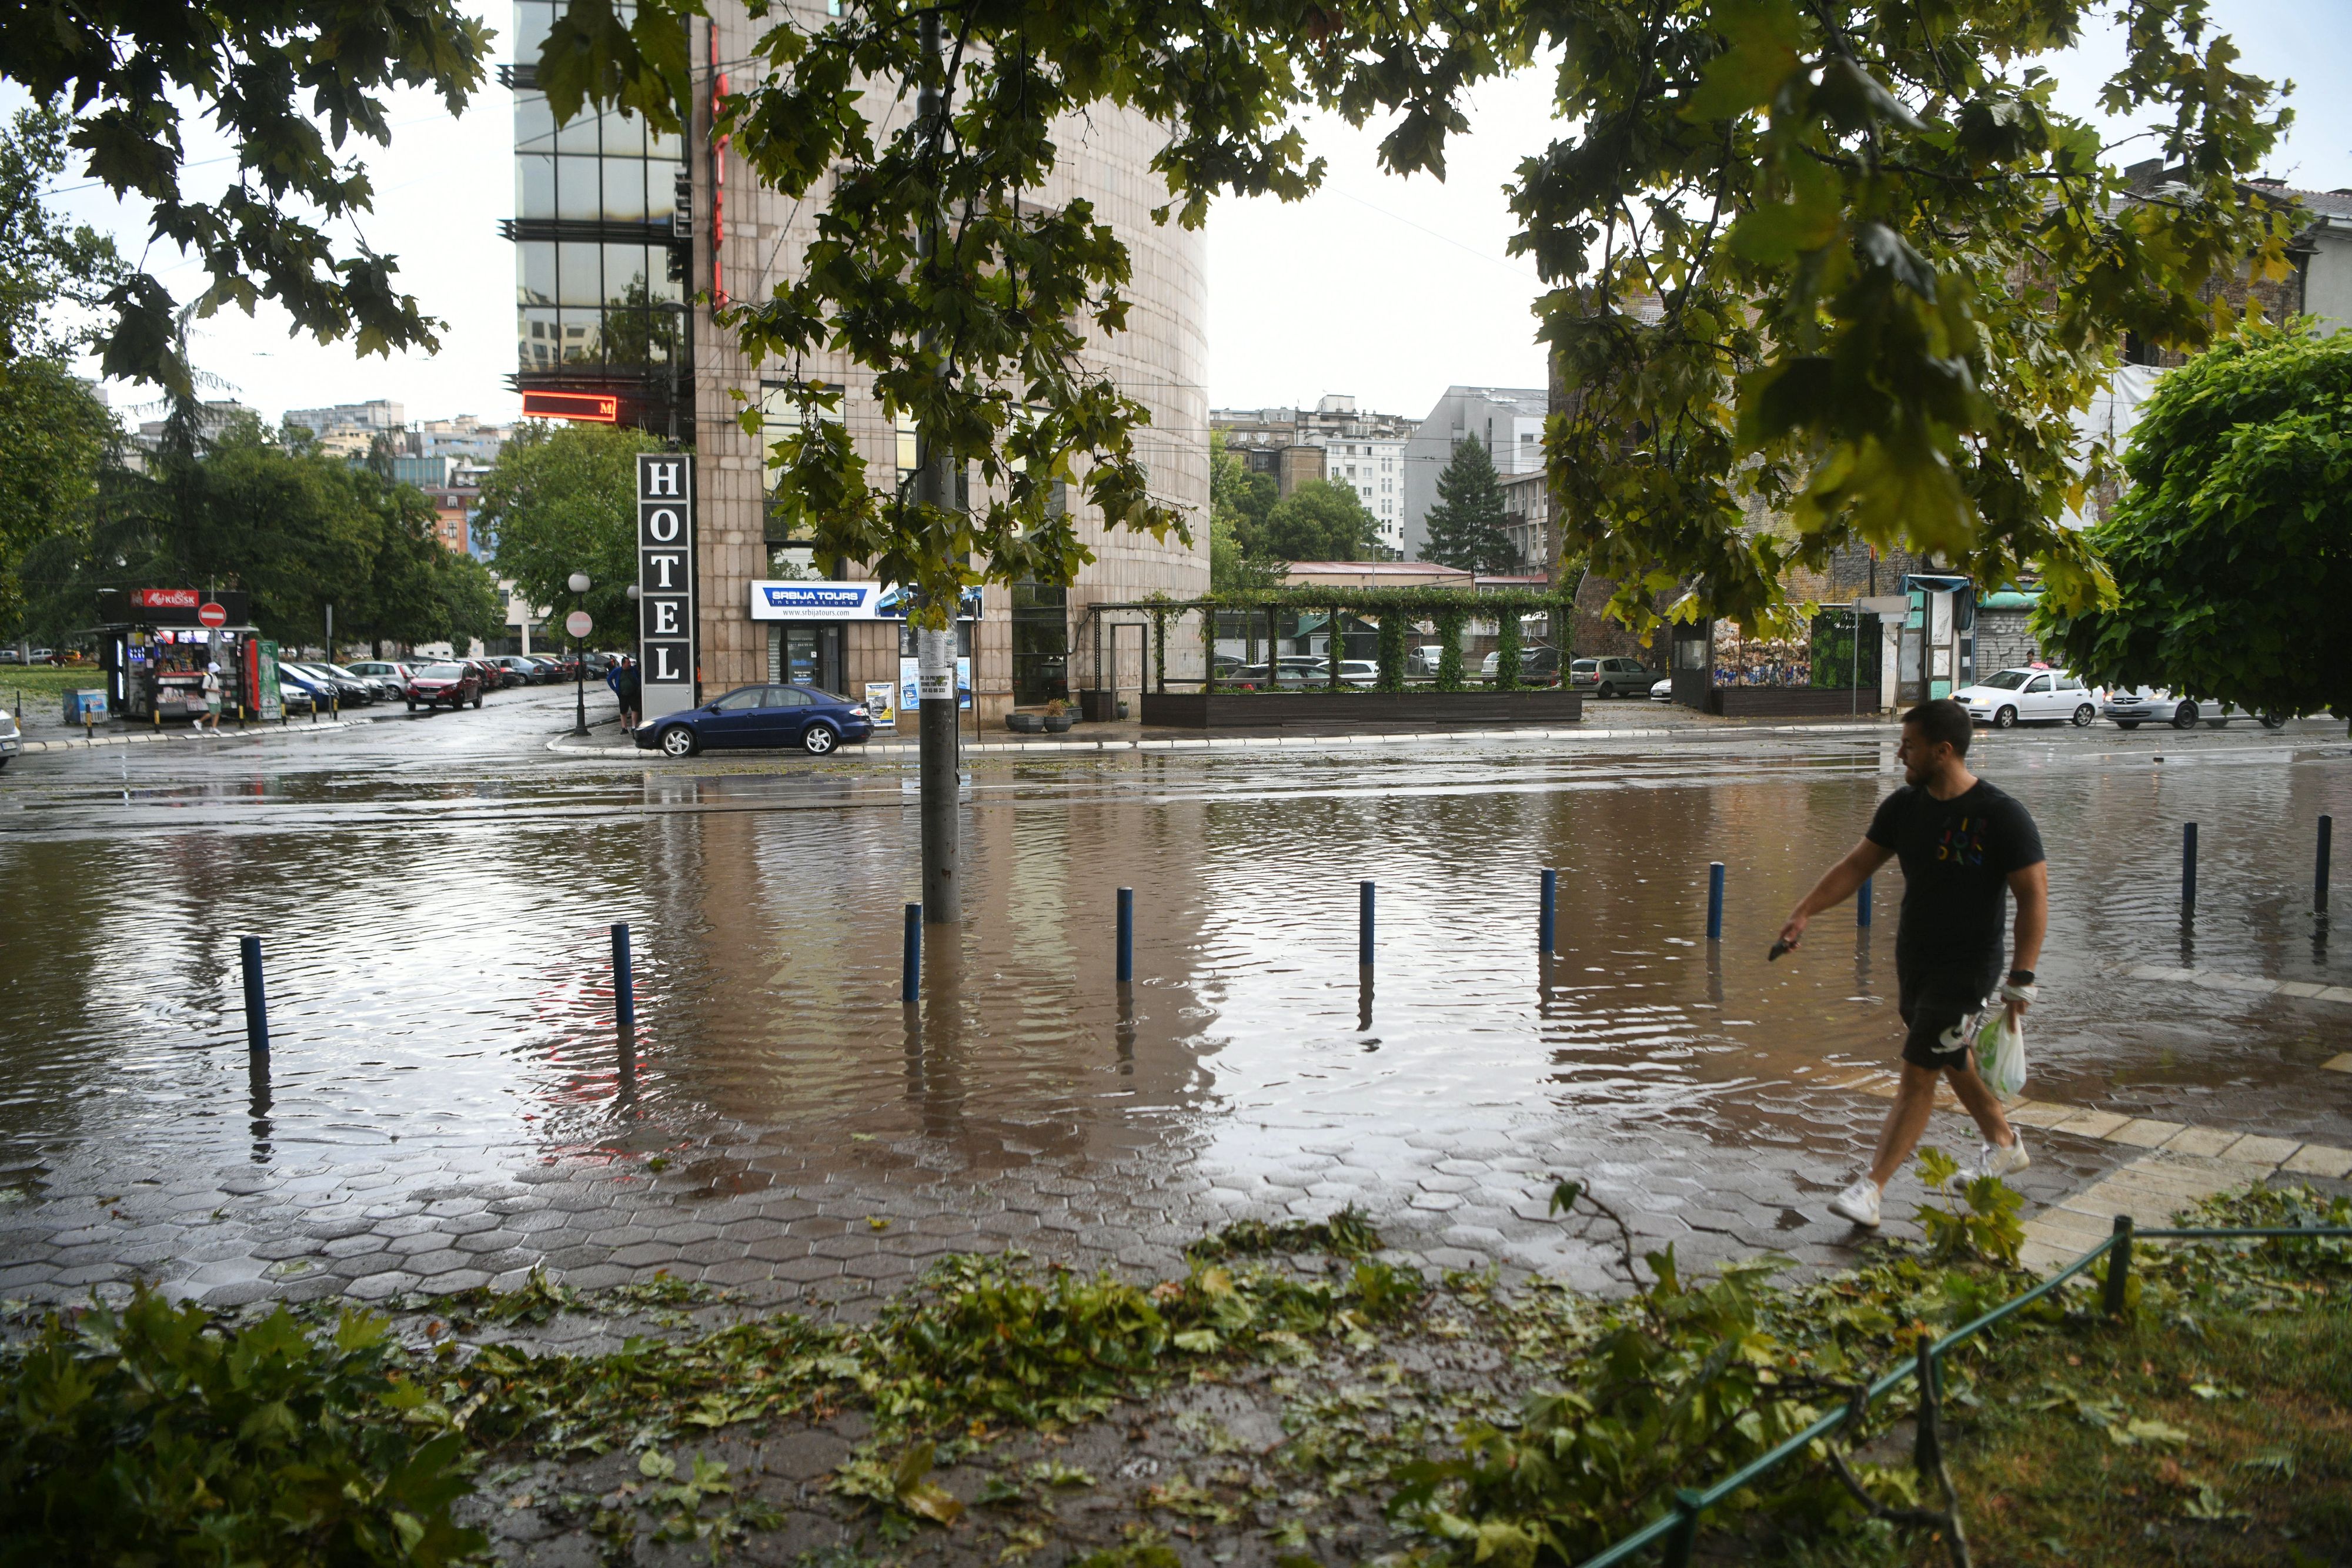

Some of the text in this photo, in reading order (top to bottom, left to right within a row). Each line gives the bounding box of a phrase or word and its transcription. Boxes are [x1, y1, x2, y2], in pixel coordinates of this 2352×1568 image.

[649, 462, 679, 680] HOTEL
[165, 591, 195, 605] KIOSK
[772, 591, 858, 600] SRBIJA TOURS
[783, 609, 850, 617] www.srbijatours.com
